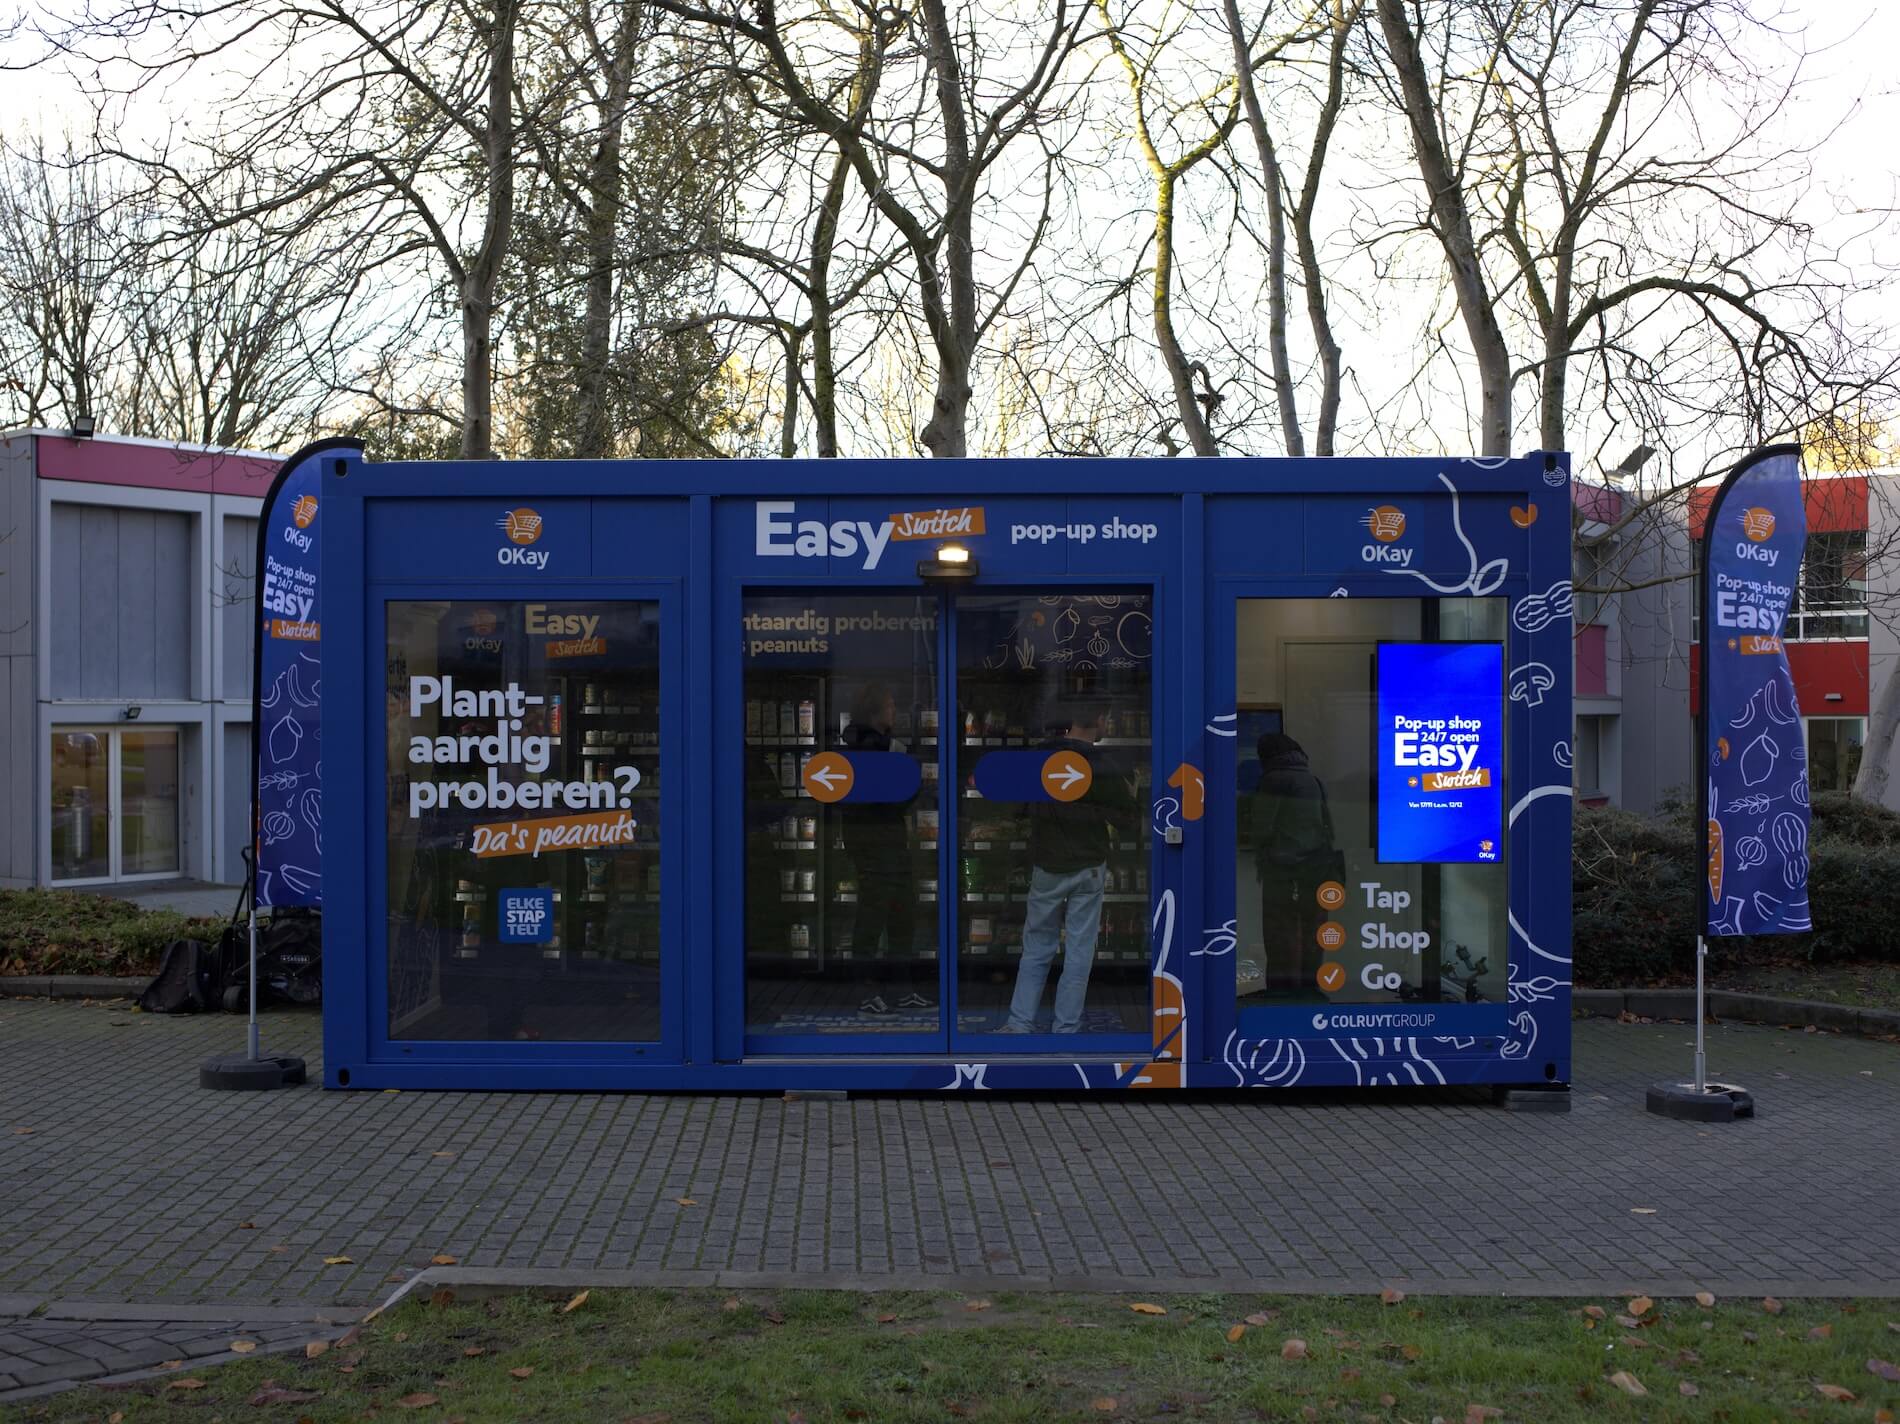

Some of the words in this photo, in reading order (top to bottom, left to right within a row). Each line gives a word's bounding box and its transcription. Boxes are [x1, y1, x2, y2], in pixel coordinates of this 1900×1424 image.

[897, 507, 973, 537] Switch
[1011, 520, 1097, 545] pop-up
[1101, 517, 1158, 543] shop
[284, 527, 313, 553] OKay
[755, 501, 894, 570] Easy
[497, 548, 549, 569] OKay
[1361, 545, 1413, 566] OKay
[1736, 542, 1779, 567] OKay
[267, 555, 294, 579] Pop-up
[294, 566, 316, 584] shop
[263, 573, 314, 624] Easy
[277, 577, 293, 590] 24/7
[293, 584, 315, 597] open
[1717, 573, 1761, 593] Pop-up
[1762, 580, 1791, 599] shop
[1739, 592, 1764, 604] 24/7
[524, 604, 601, 639] Easy
[1717, 591, 1784, 639] Easy
[278, 620, 317, 639] Switch
[465, 637, 502, 652] OKay
[555, 635, 599, 657] Switch
[750, 637, 829, 656] peanuts
[409, 675, 544, 717] Plant-
[1394, 715, 1446, 732] Pop-up
[1448, 715, 1481, 732] shop
[408, 719, 551, 773] aardig
[1421, 732, 1447, 742] 24/7
[1450, 733, 1480, 744] open
[1394, 732, 1479, 773] Easy
[1432, 766, 1482, 789] Switch
[408, 765, 641, 818] proberen?
[469, 824, 529, 854] Da's
[532, 815, 638, 859] peanuts
[1478, 851, 1496, 860] OKay
[506, 897, 544, 910] ELKE
[1360, 882, 1411, 914] Tap
[506, 910, 546, 924] STAP
[506, 924, 541, 936] TELT
[1361, 922, 1430, 953] Shop
[1360, 963, 1402, 990] Go
